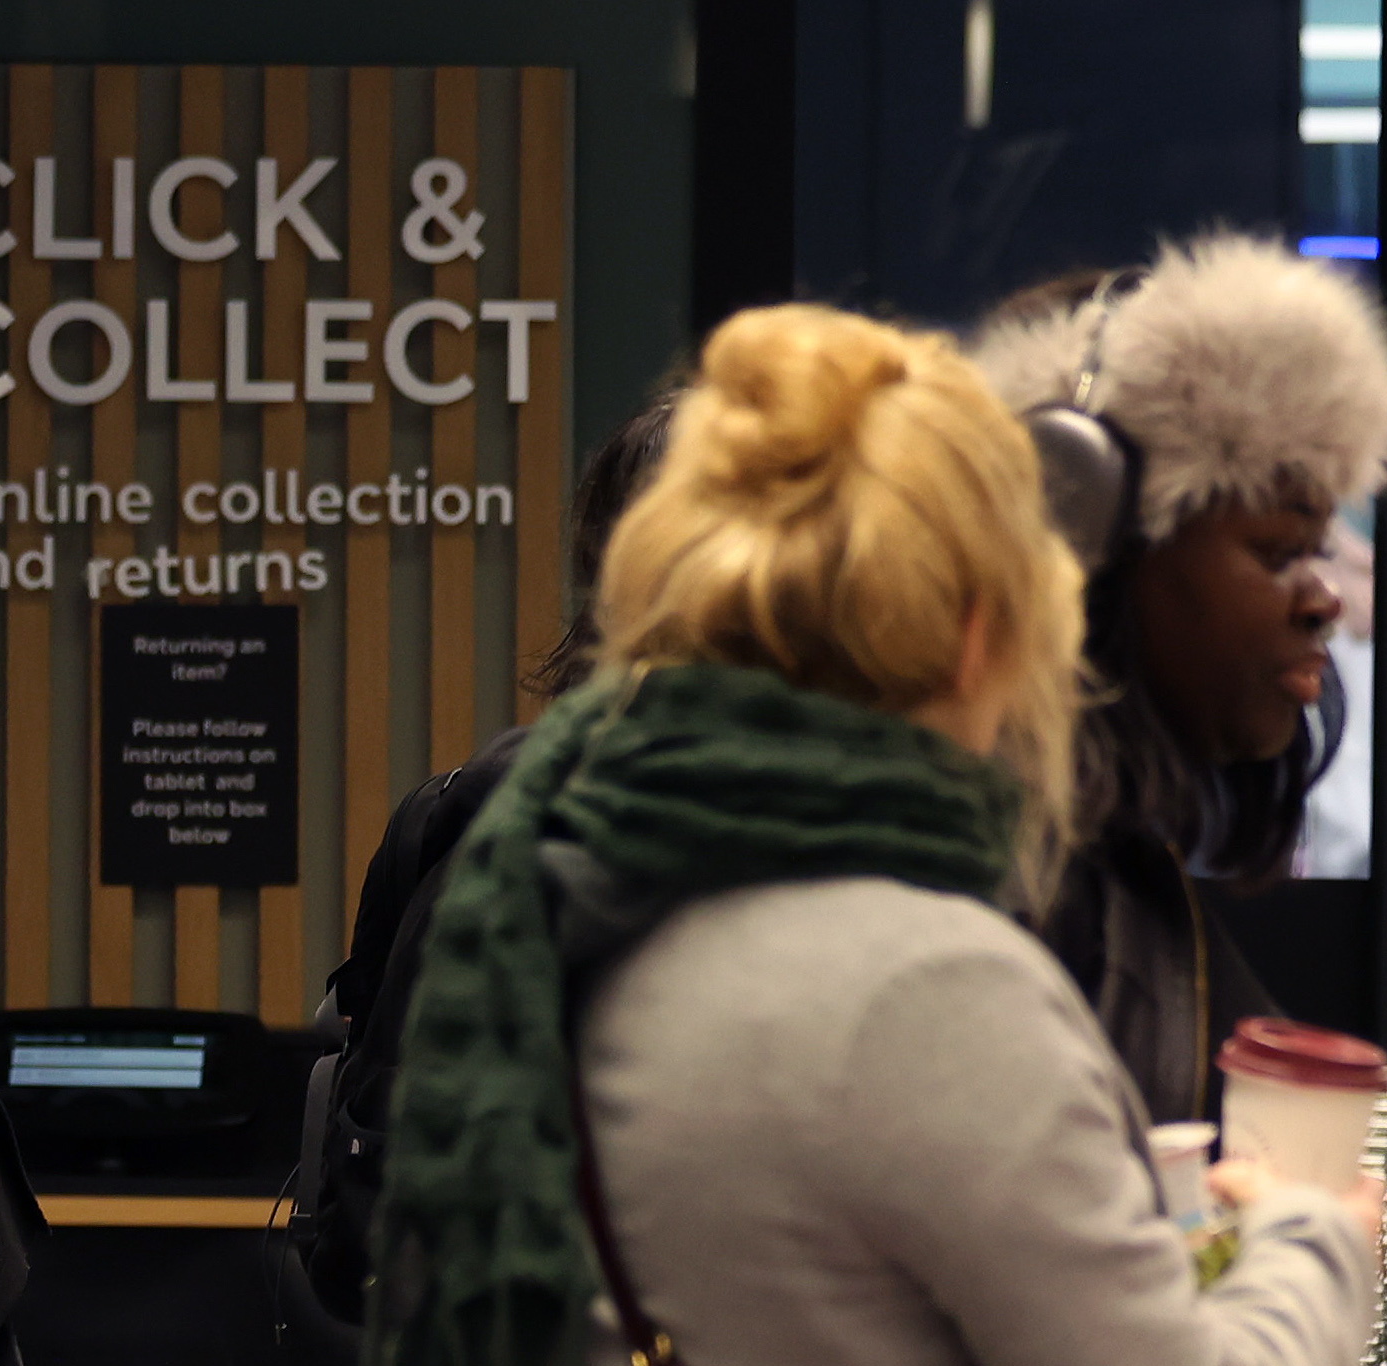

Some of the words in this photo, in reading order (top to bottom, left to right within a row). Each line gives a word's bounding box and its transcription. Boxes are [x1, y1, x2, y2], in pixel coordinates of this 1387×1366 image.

[401, 157, 485, 264] &
[181, 468, 514, 525] collection
[88, 543, 329, 600] returns
[133, 636, 236, 659] Returning
[239, 639, 266, 655] an
[171, 663, 228, 682] item?
[132, 720, 198, 737] Please
[204, 719, 267, 737] follow
[122, 747, 244, 764] instructions
[249, 749, 276, 764] on
[144, 773, 205, 791] tablet
[216, 773, 256, 791] and
[131, 799, 179, 821] drop
[184, 799, 225, 818] into
[230, 799, 267, 818] box
[169, 825, 231, 844] below
